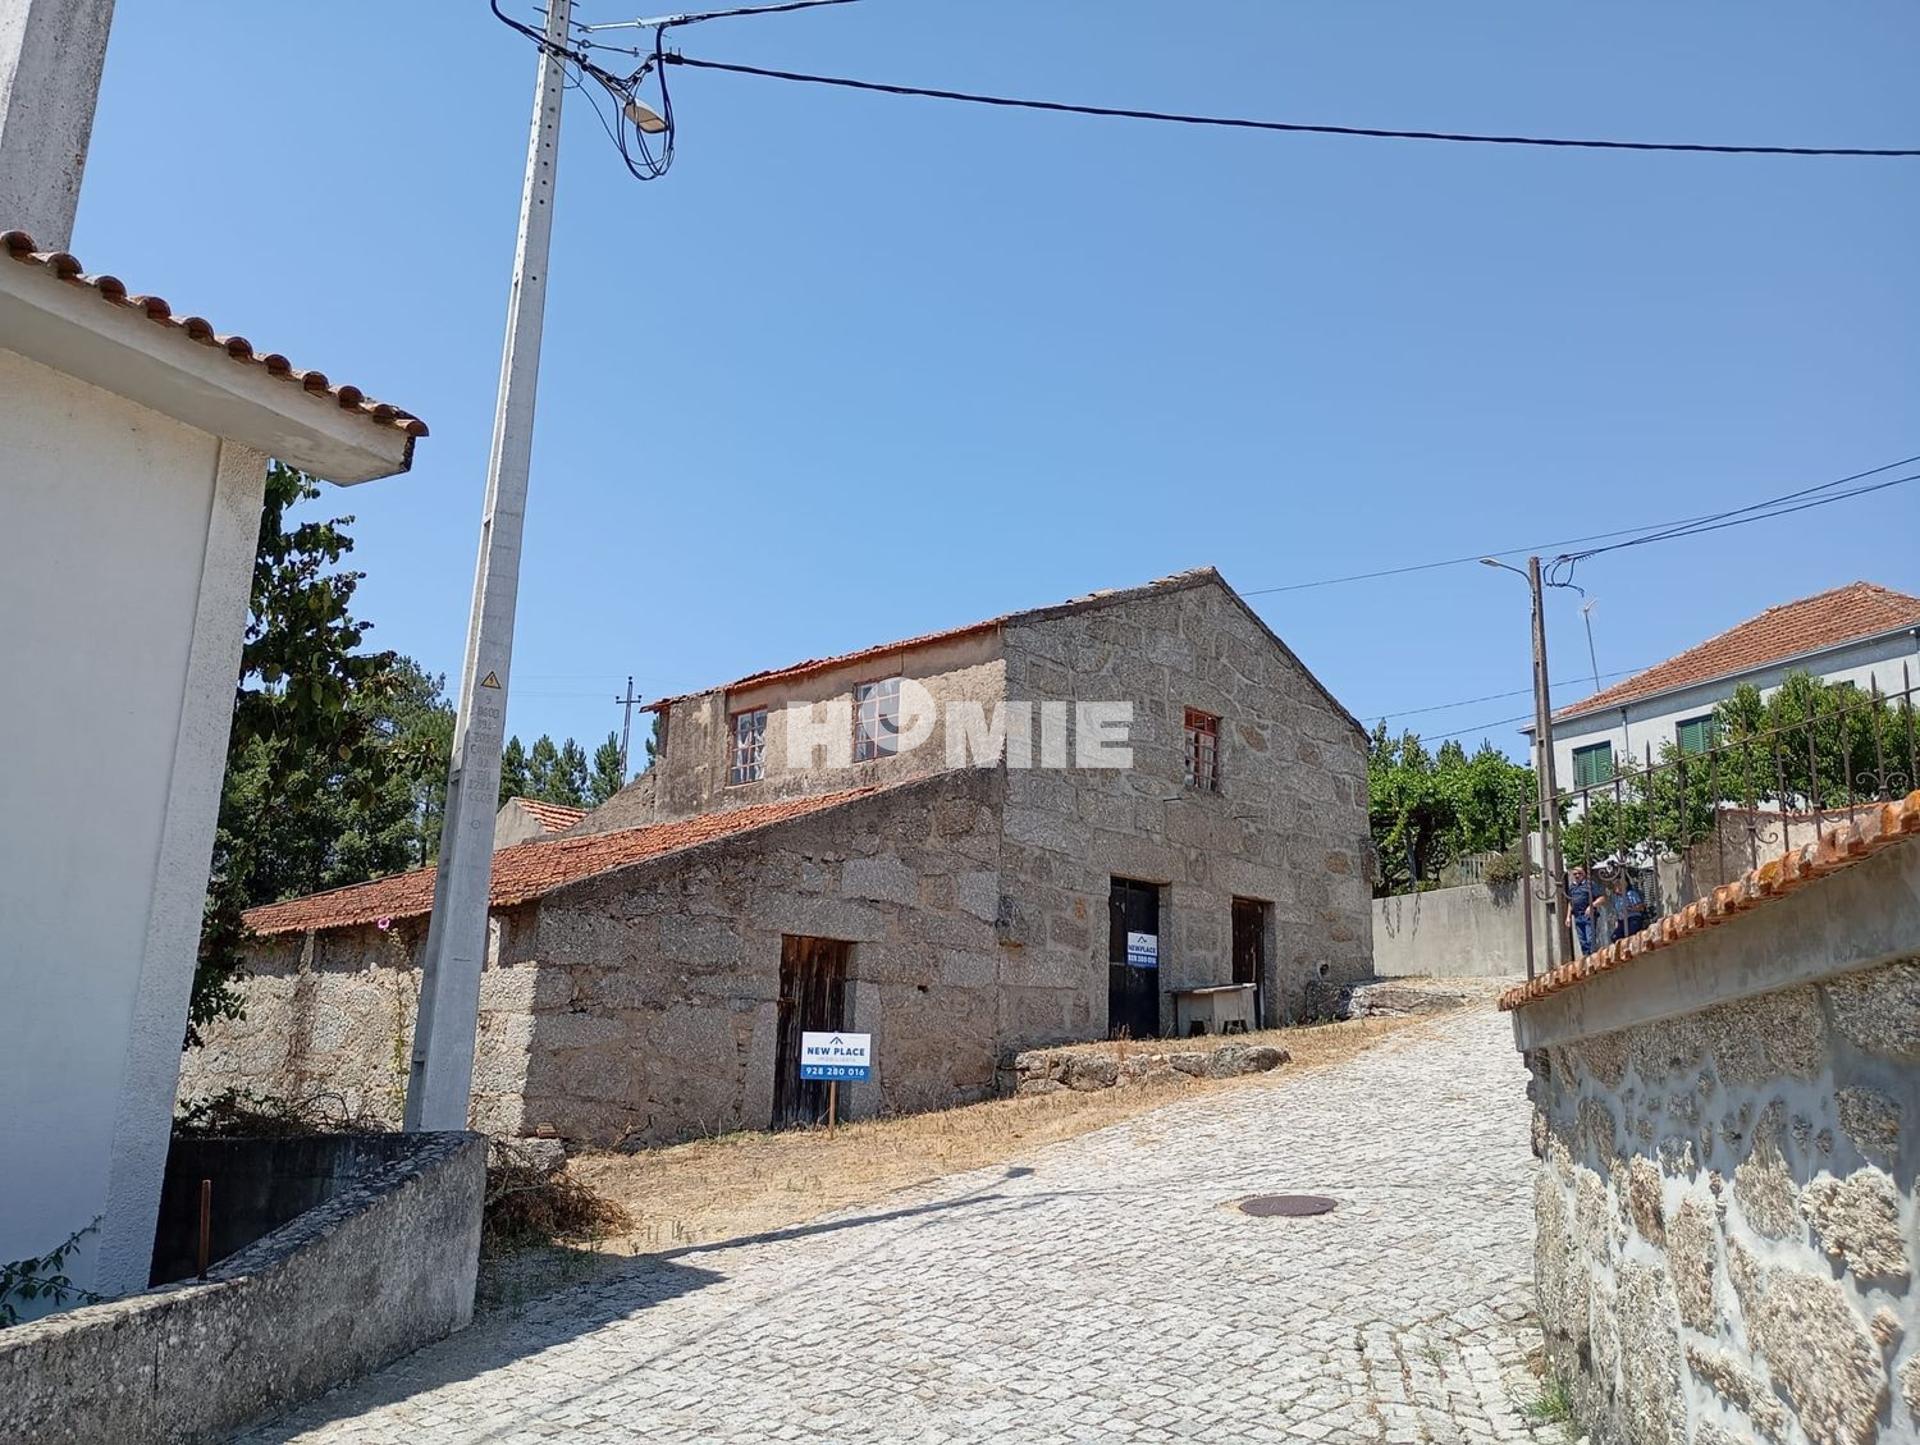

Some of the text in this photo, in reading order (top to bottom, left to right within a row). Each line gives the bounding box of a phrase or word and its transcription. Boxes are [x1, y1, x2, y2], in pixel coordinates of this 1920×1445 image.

[807, 1047, 865, 1057] NEW PLACE
[806, 1067, 865, 1076] 928 280 016
